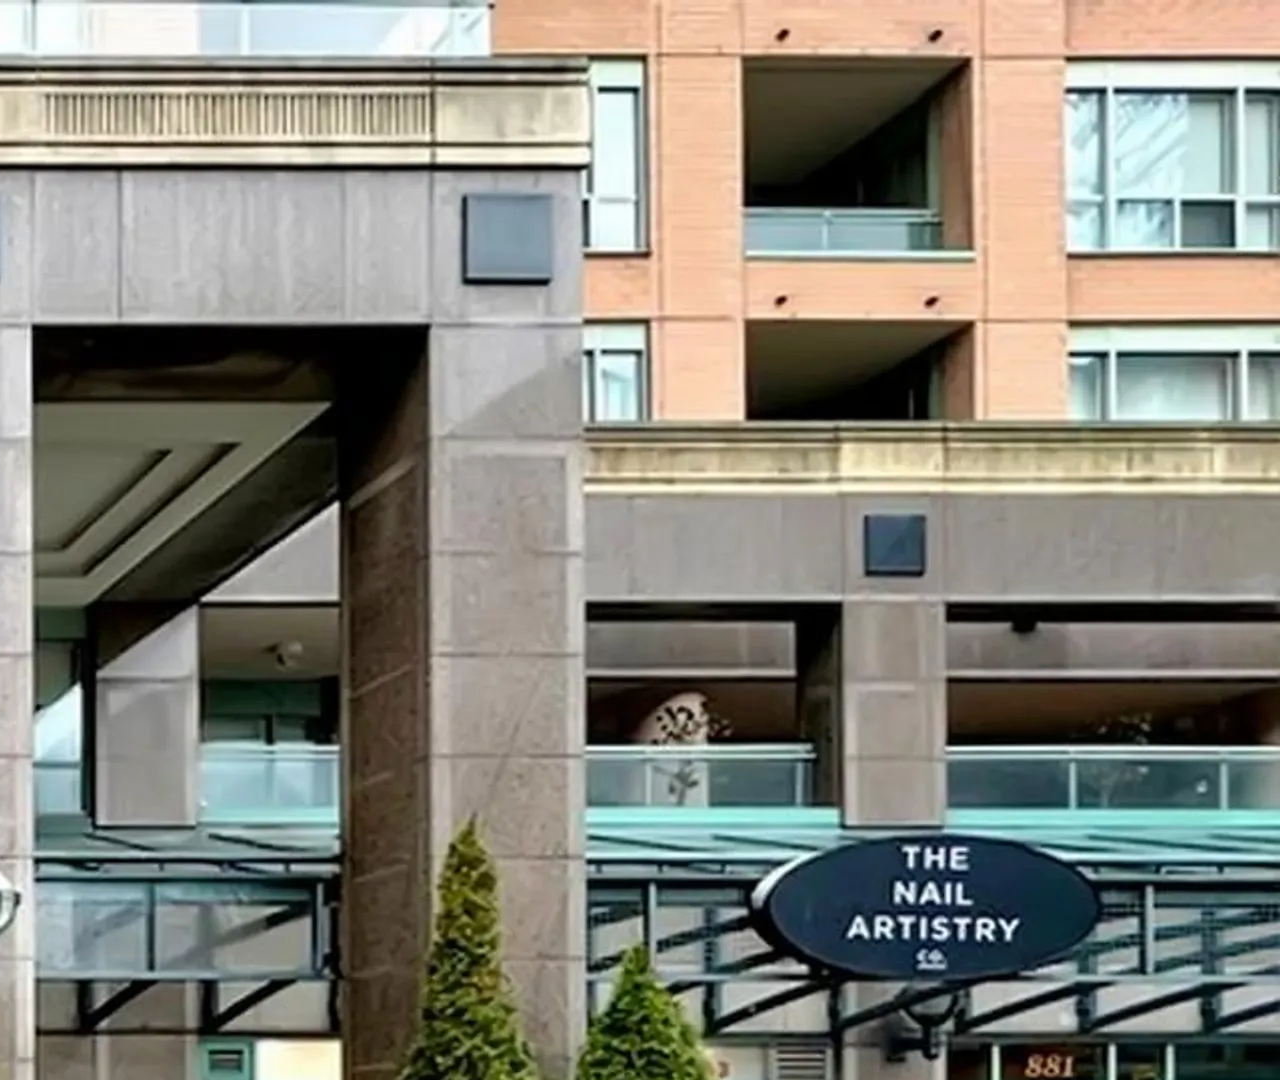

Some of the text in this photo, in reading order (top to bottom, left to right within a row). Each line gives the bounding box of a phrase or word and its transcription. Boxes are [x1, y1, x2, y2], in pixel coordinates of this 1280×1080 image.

[901, 846, 970, 871] THE
[892, 881, 974, 906] NAIL
[846, 914, 1020, 942] ARTISTRY
[1024, 1054, 1075, 1078] 881
